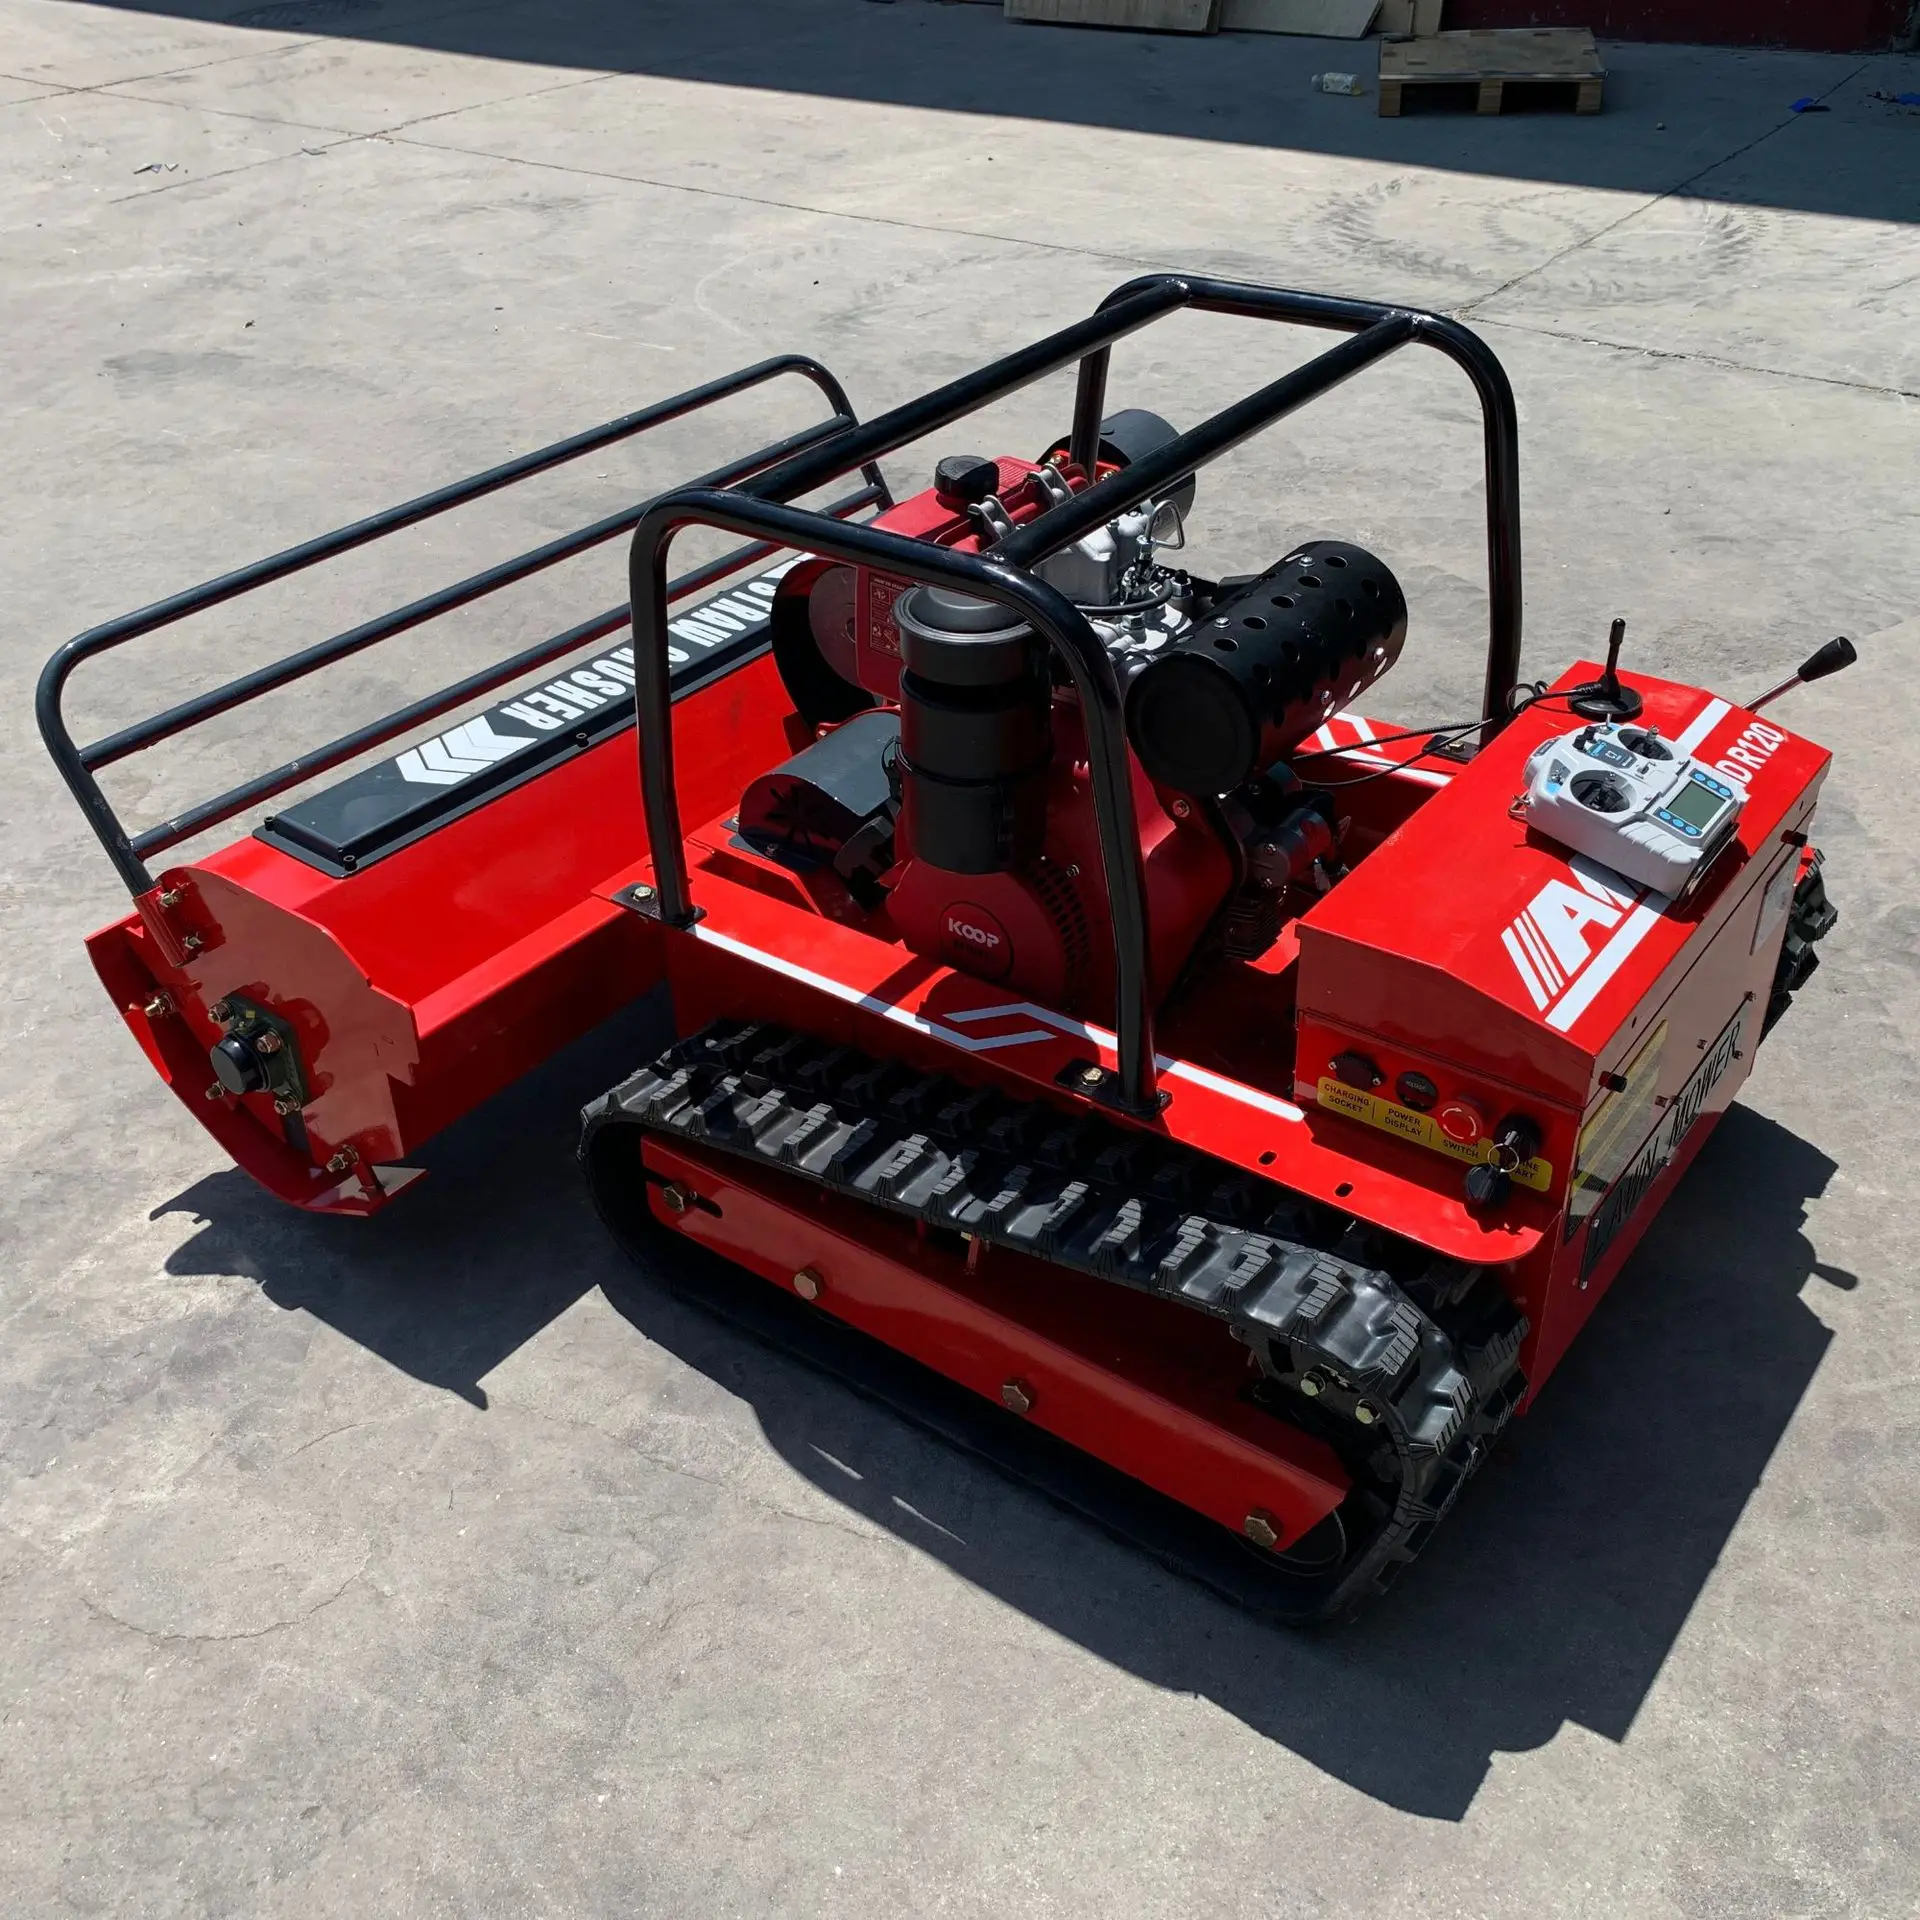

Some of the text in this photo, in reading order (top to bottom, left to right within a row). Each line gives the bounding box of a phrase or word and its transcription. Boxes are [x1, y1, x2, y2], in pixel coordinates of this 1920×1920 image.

[948, 917, 1000, 949] KOOP
[1324, 1083, 1371, 1107] CHARGING
[1667, 1020, 1742, 1151] MOWER
[1328, 1095, 1365, 1114] SOCKET
[1384, 1116, 1423, 1137] DISPLAY
[1387, 1107, 1421, 1125] POWER
[1443, 1138, 1480, 1159] SWITCH
